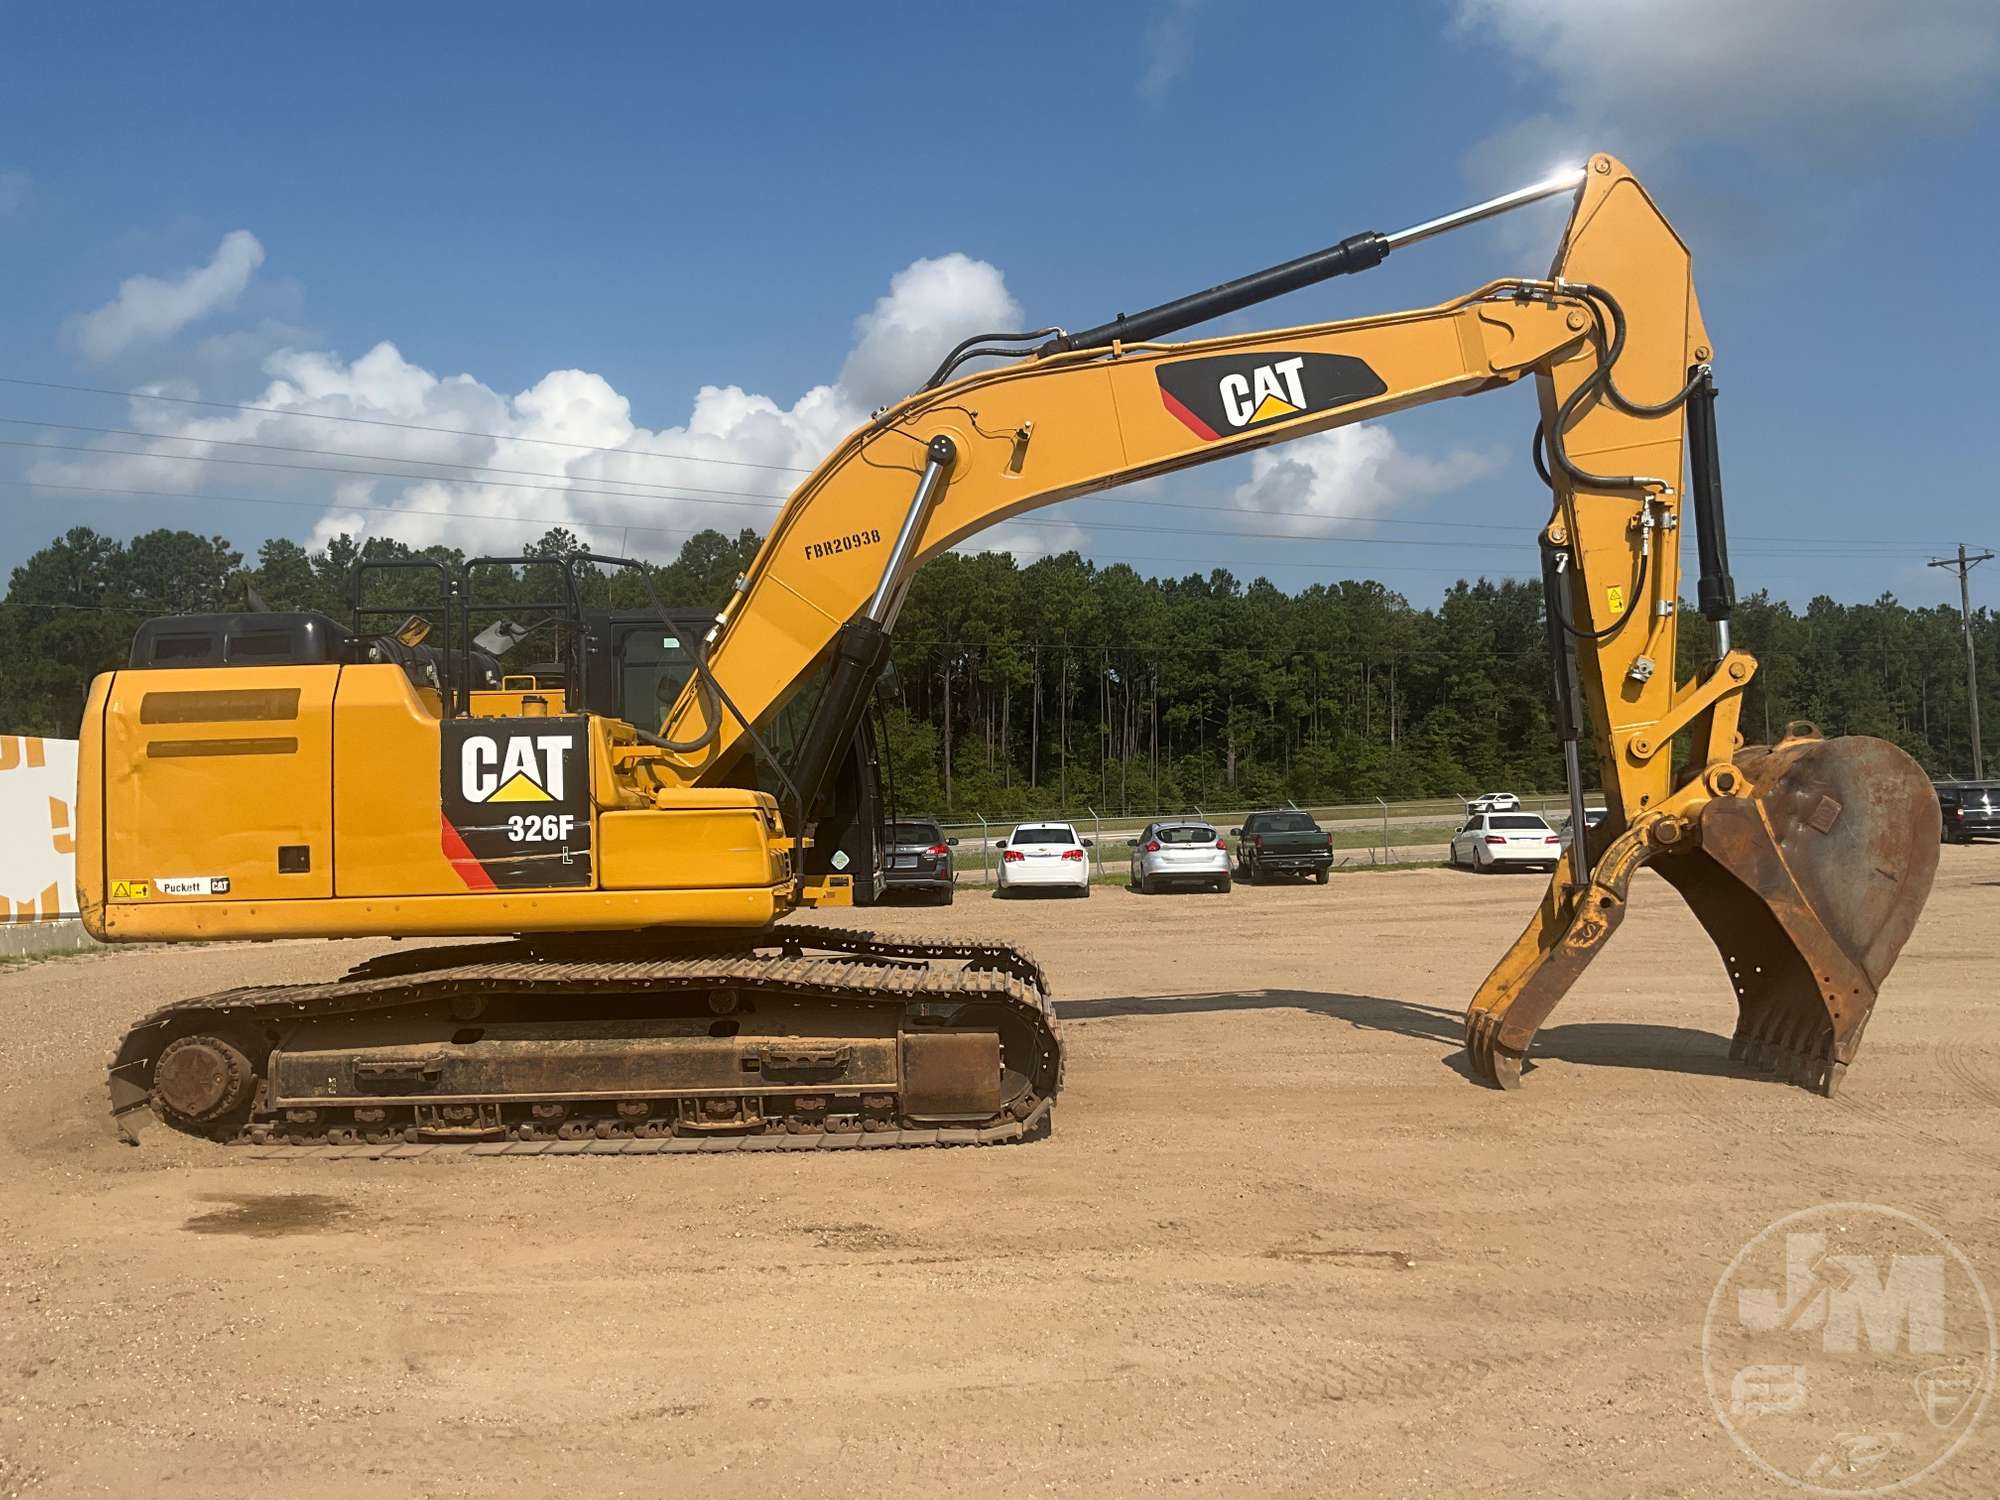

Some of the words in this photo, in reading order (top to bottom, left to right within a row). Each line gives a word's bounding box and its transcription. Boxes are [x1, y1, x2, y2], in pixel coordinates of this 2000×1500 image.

[1219, 356, 1307, 427] CAT
[805, 529, 881, 561] FBR20938
[461, 735, 573, 803] CAT
[507, 815, 574, 842] 326F
[562, 846, 574, 865] L
[164, 883, 200, 893] Puckett
[211, 880, 229, 892] CAT
